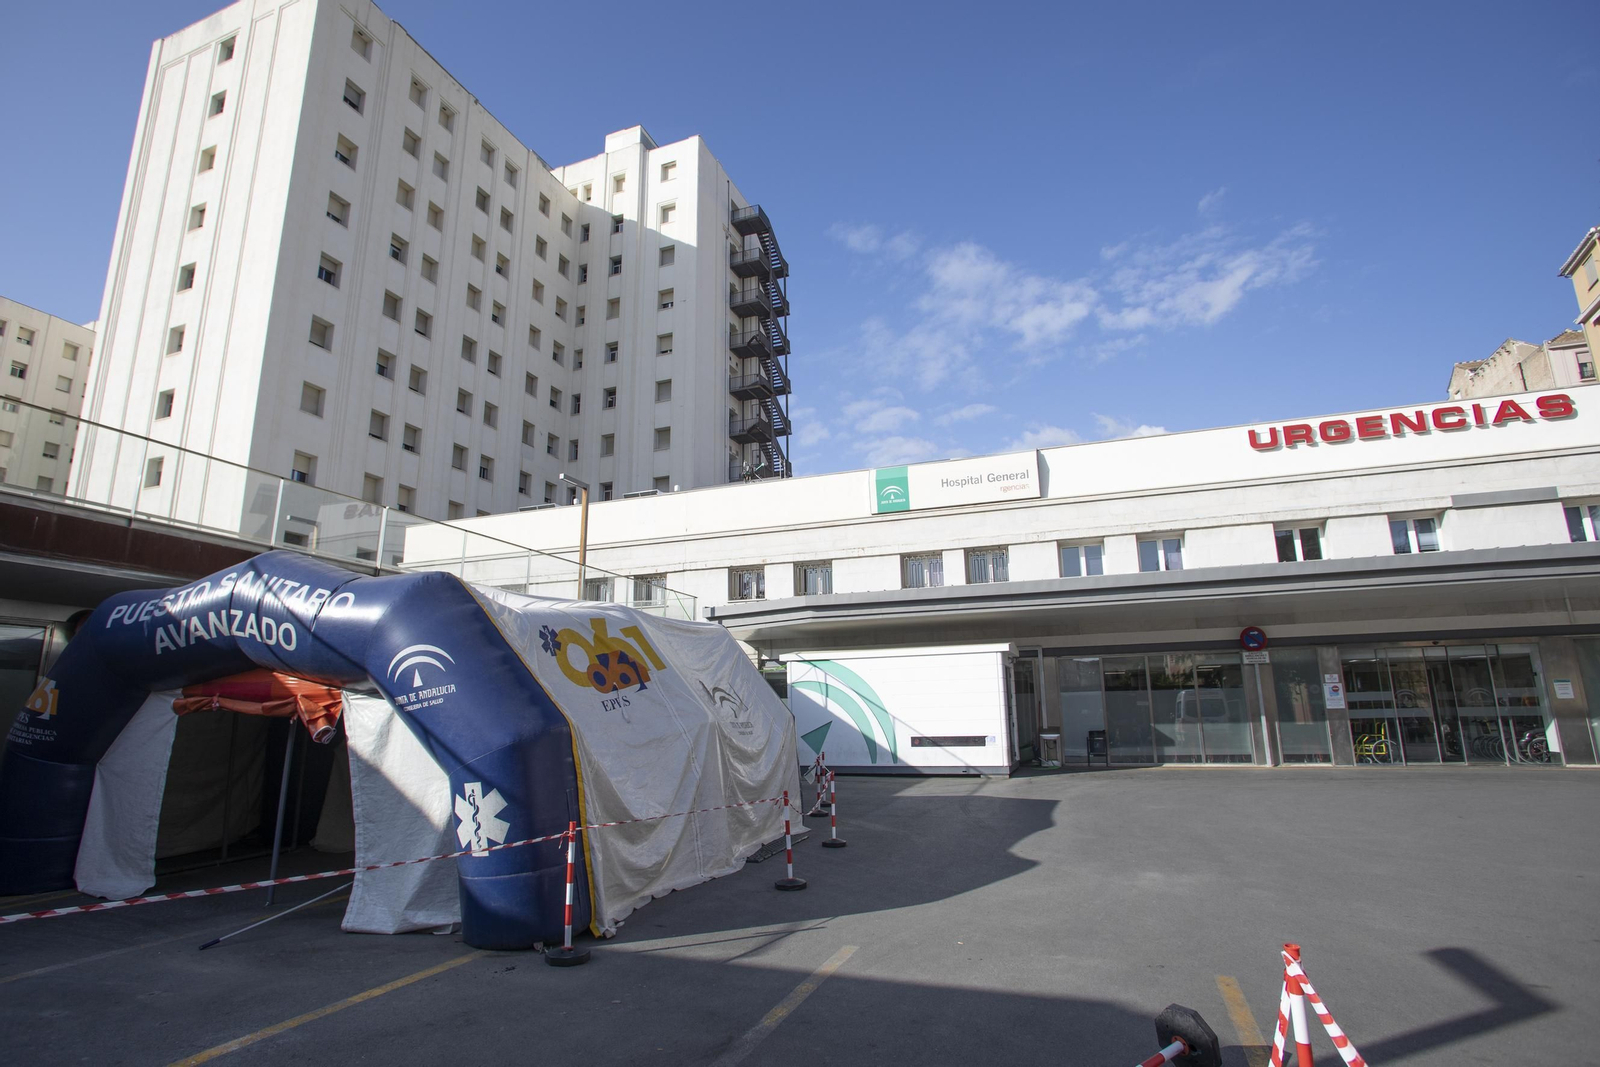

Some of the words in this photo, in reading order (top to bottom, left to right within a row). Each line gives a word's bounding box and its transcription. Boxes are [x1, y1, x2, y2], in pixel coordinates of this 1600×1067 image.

[1247, 393, 1576, 451] URGENCIAS
[941, 474, 983, 488] Hospital
[987, 469, 1030, 483] General
[105, 581, 212, 629] PUESTO
[155, 608, 298, 655] AVANZADO
[418, 684, 457, 700] ANDALUCIA
[429, 697, 444, 706] SALUD
